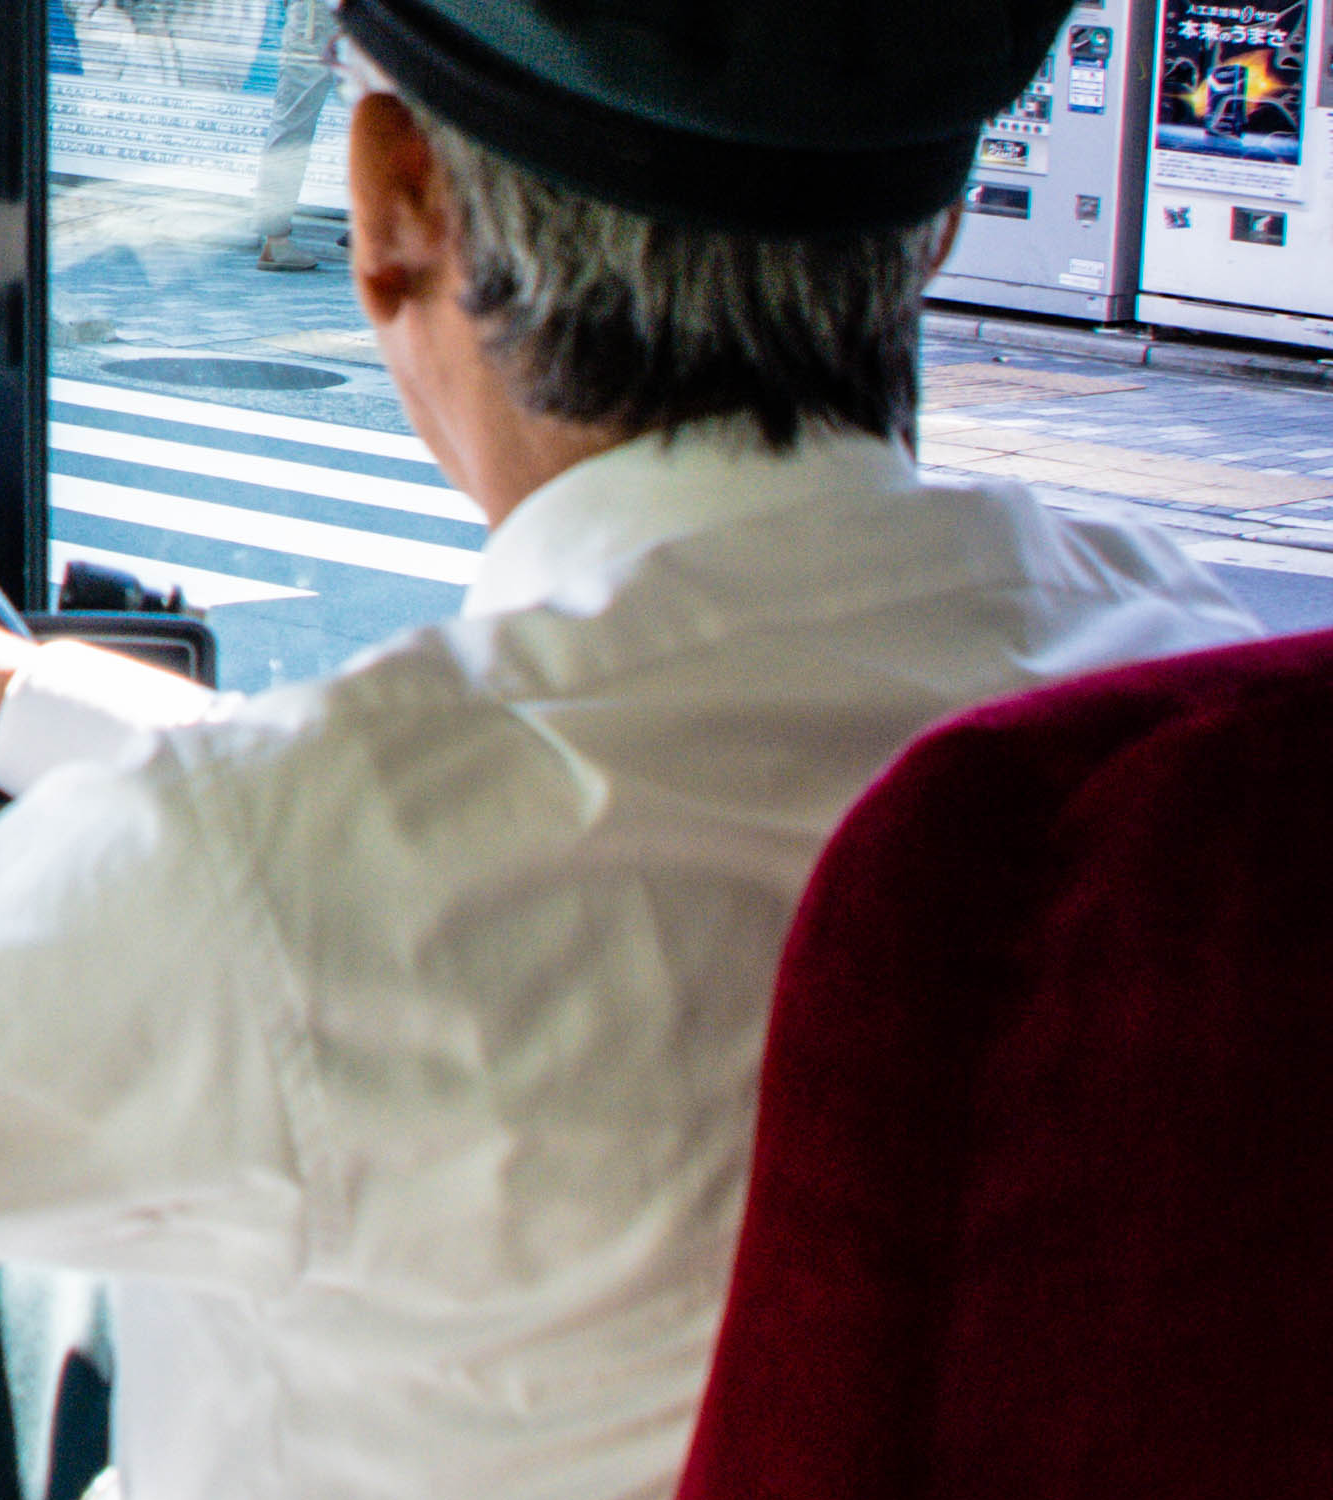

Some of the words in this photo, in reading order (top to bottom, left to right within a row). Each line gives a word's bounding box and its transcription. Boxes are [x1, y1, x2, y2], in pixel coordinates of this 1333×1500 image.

[1178, 19, 1289, 48] 本来のうまさ
